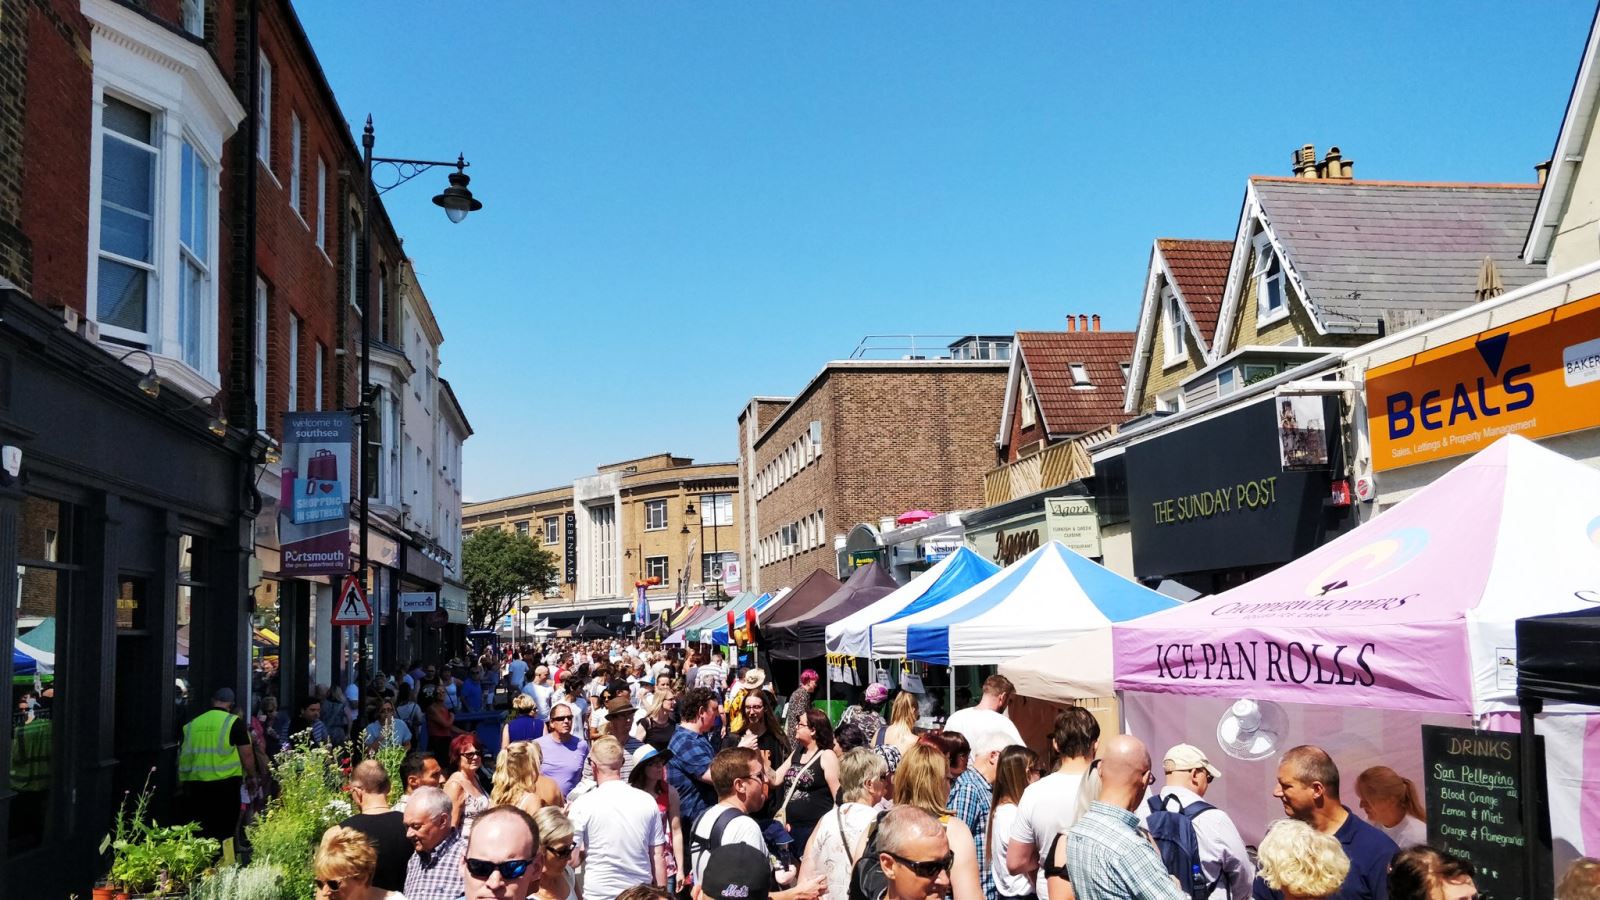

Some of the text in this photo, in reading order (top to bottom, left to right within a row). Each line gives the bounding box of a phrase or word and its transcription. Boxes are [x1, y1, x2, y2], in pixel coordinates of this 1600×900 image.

[1386, 363, 1535, 440] BEALS
[292, 418, 343, 428] welcome to
[295, 429, 339, 438] southsea
[1413, 441, 1441, 454] Lettings
[1442, 437, 1448, 447] &
[1450, 431, 1482, 446] Property
[1483, 417, 1537, 438] Management
[296, 497, 342, 509] SHOPPING
[1053, 503, 1089, 516] Agora
[1152, 476, 1277, 524] THE SUNDAY POST
[285, 550, 344, 562] Portsmouth
[993, 529, 1040, 568] Agora
[1156, 641, 1376, 687] ICE PAN ROLLS
[1447, 737, 1512, 760] DRINKS
[1433, 763, 1515, 790] San Pellegrino
[1441, 787, 1499, 809] Blood Orange
[1441, 803, 1467, 818] Lemon
[1481, 809, 1504, 824] Mint
[1440, 823, 1468, 841] Orange
[721, 883, 749, 898] Mets
